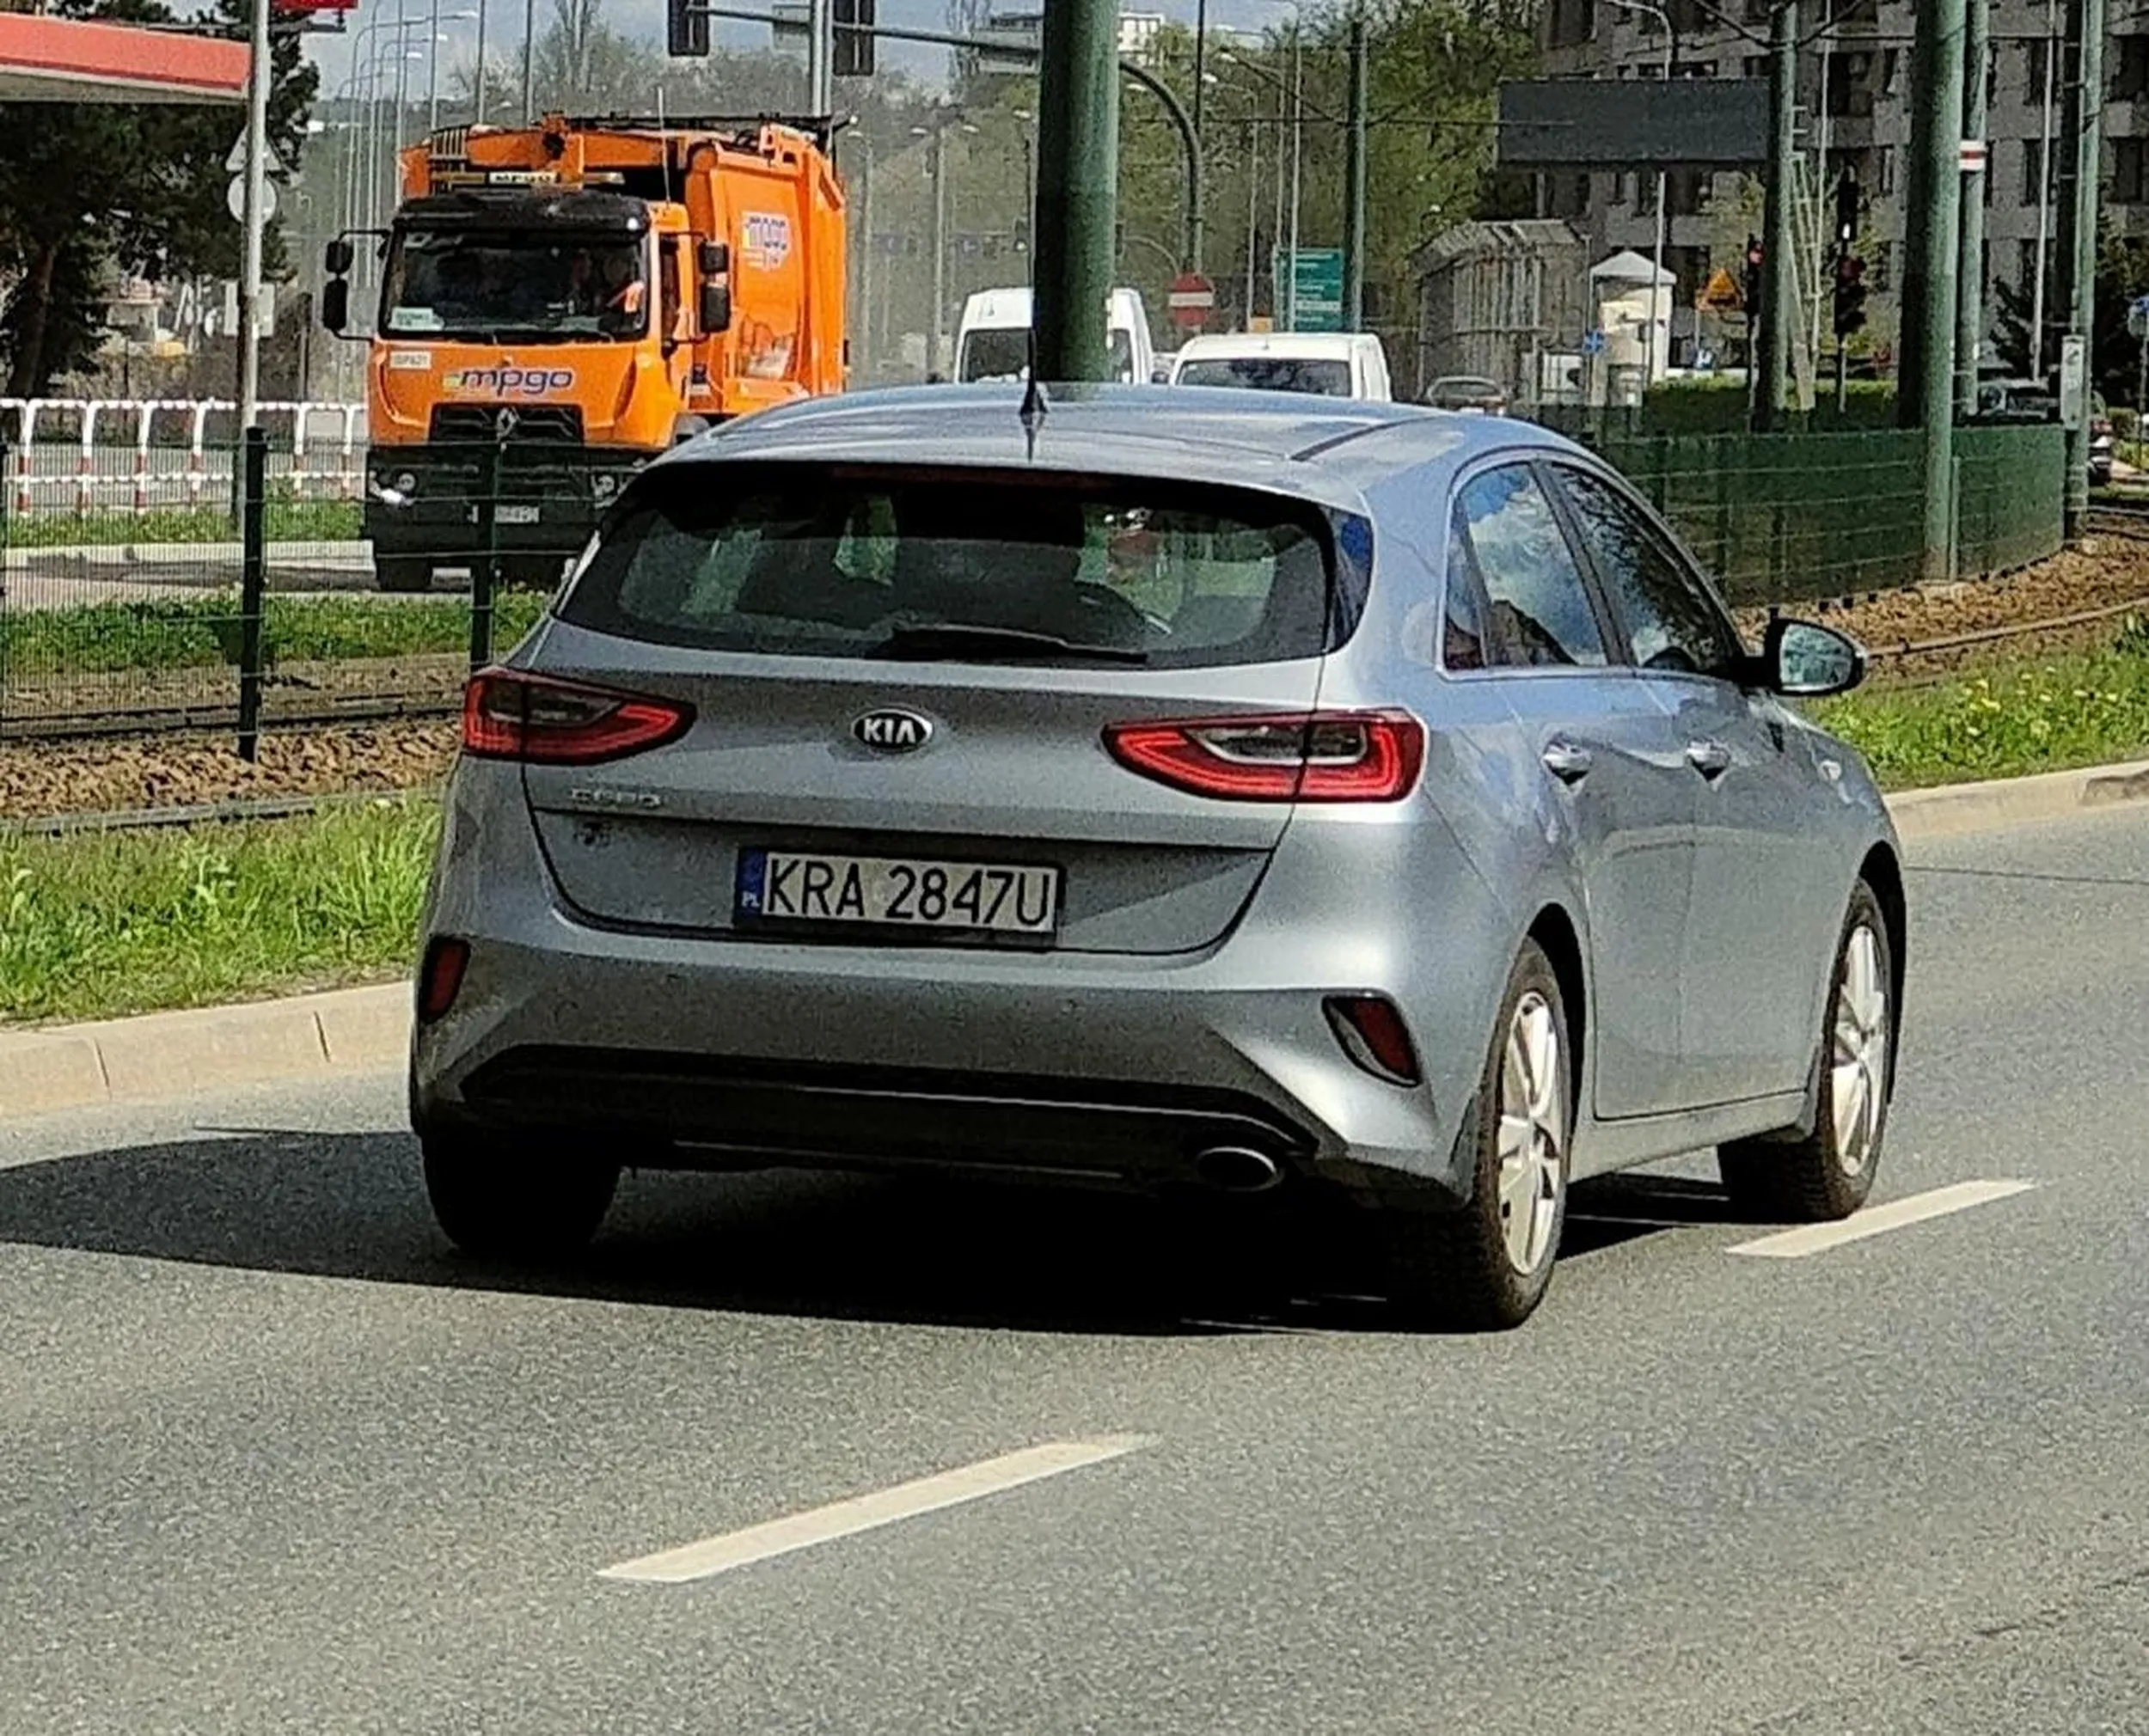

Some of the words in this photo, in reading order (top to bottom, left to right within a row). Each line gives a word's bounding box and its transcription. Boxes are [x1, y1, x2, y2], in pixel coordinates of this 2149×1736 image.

[461, 369, 573, 397] mpgo
[863, 717, 916, 744] KIA
[741, 890, 761, 908] PL
[767, 859, 866, 917] KRA
[885, 865, 1050, 926] 2847U
